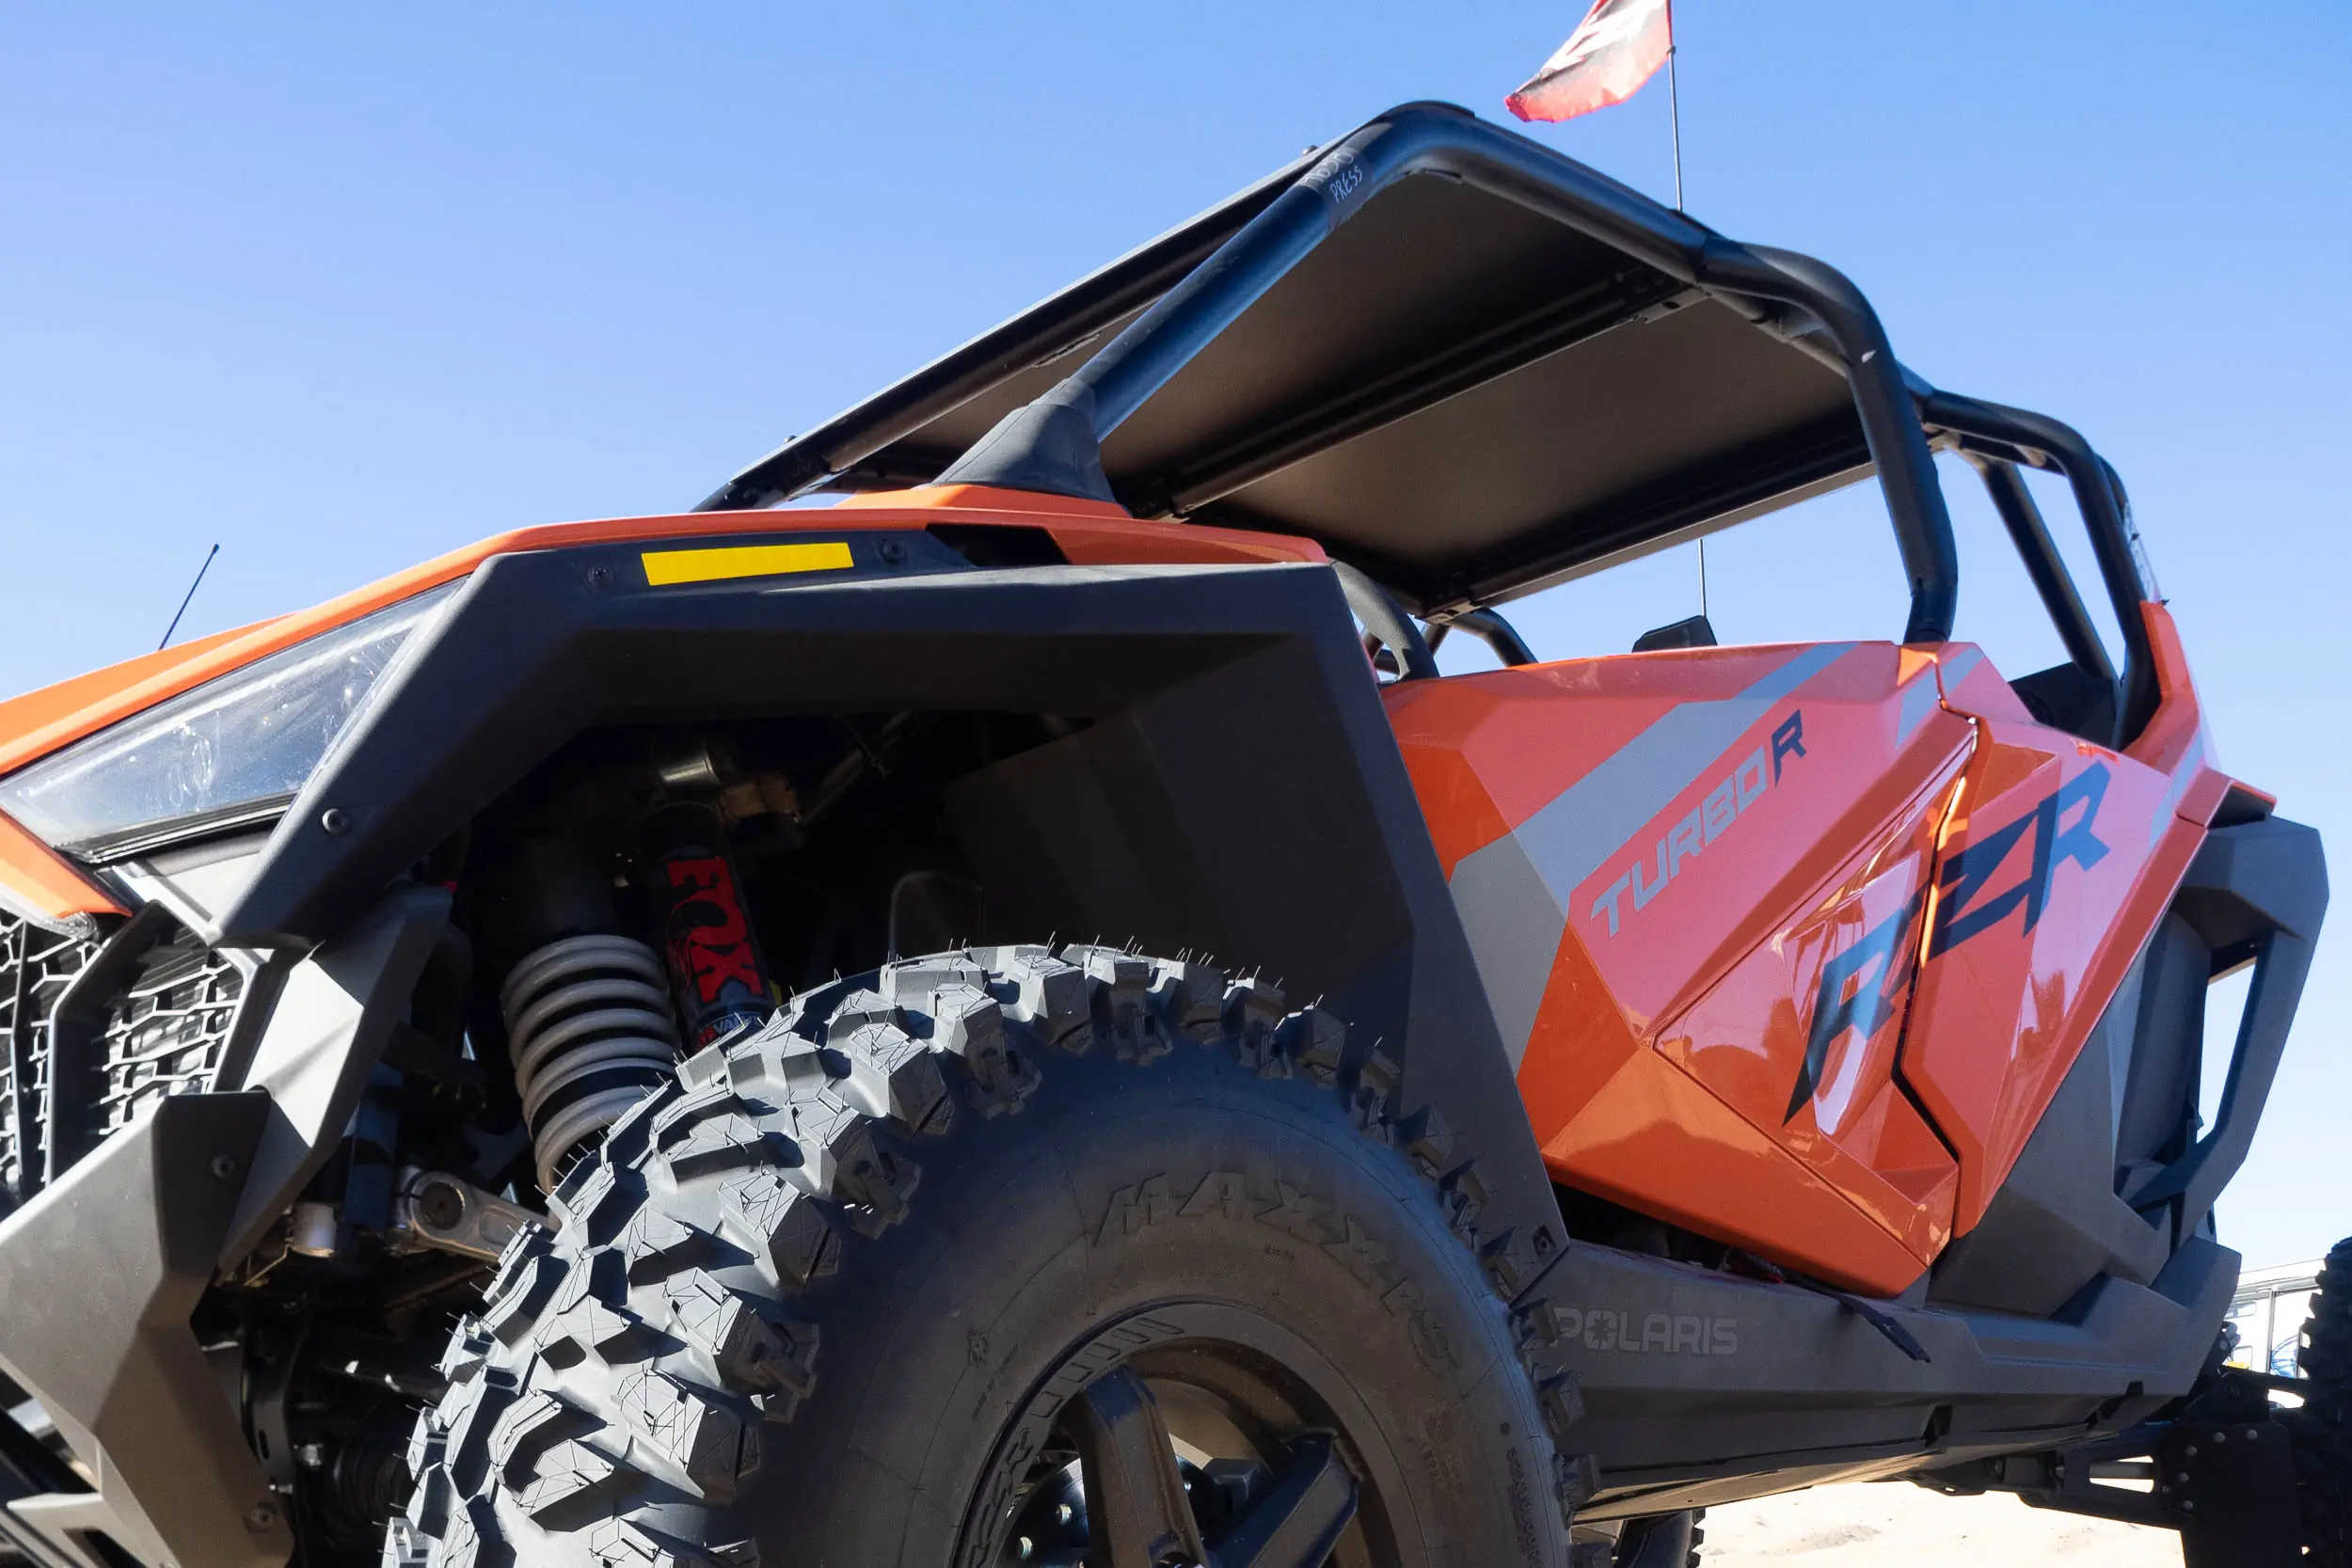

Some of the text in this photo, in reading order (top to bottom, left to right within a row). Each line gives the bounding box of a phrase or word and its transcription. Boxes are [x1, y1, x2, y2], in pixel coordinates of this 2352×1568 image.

[1329, 165, 1363, 203] PRESS
[1590, 708, 1806, 939] TURBO R
[665, 855, 765, 1003] FOX
[1782, 760, 2111, 1129] RZR
[1549, 1306, 1739, 1355] POLARIS
